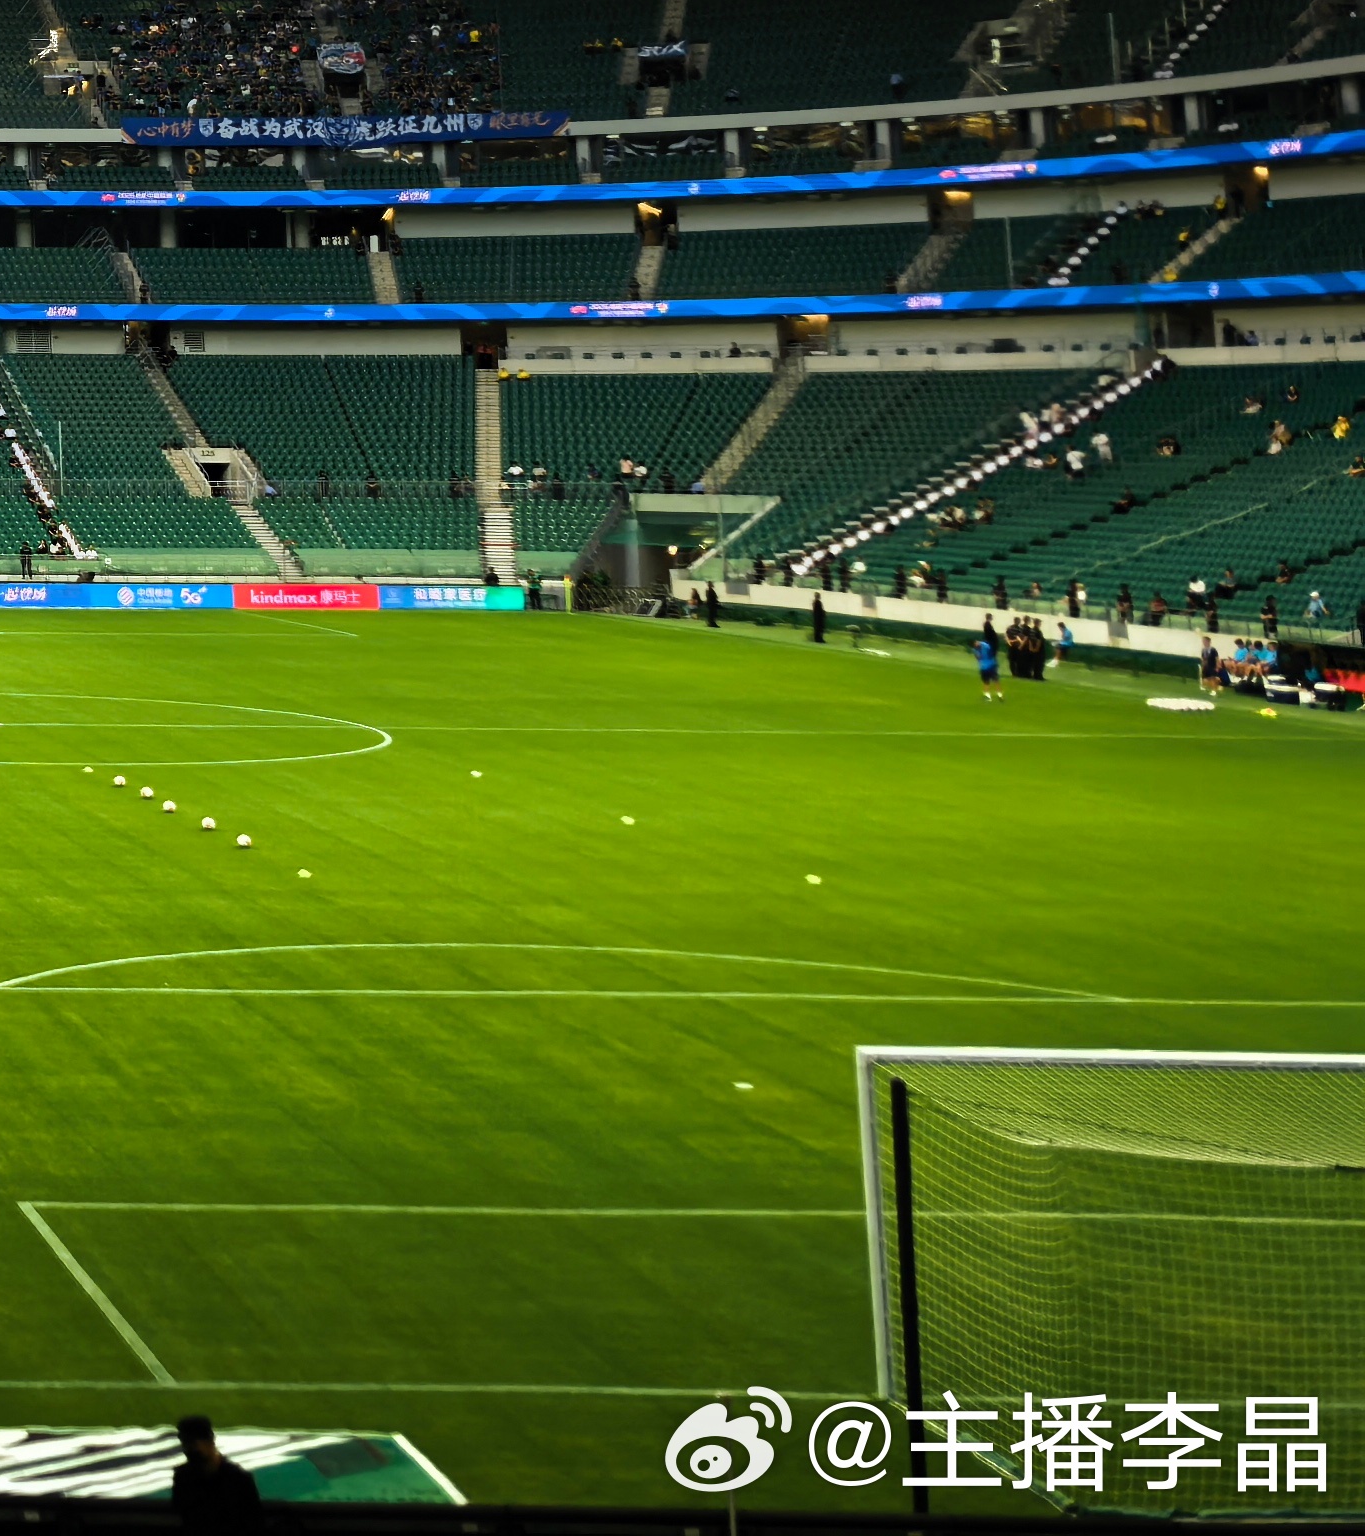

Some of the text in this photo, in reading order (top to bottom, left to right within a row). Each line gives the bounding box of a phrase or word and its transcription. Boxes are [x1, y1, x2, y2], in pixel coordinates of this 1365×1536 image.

[137, 120, 195, 137] 心中有梦
[217, 117, 326, 139] 奋战为武汉
[251, 589, 317, 605] kindmax
